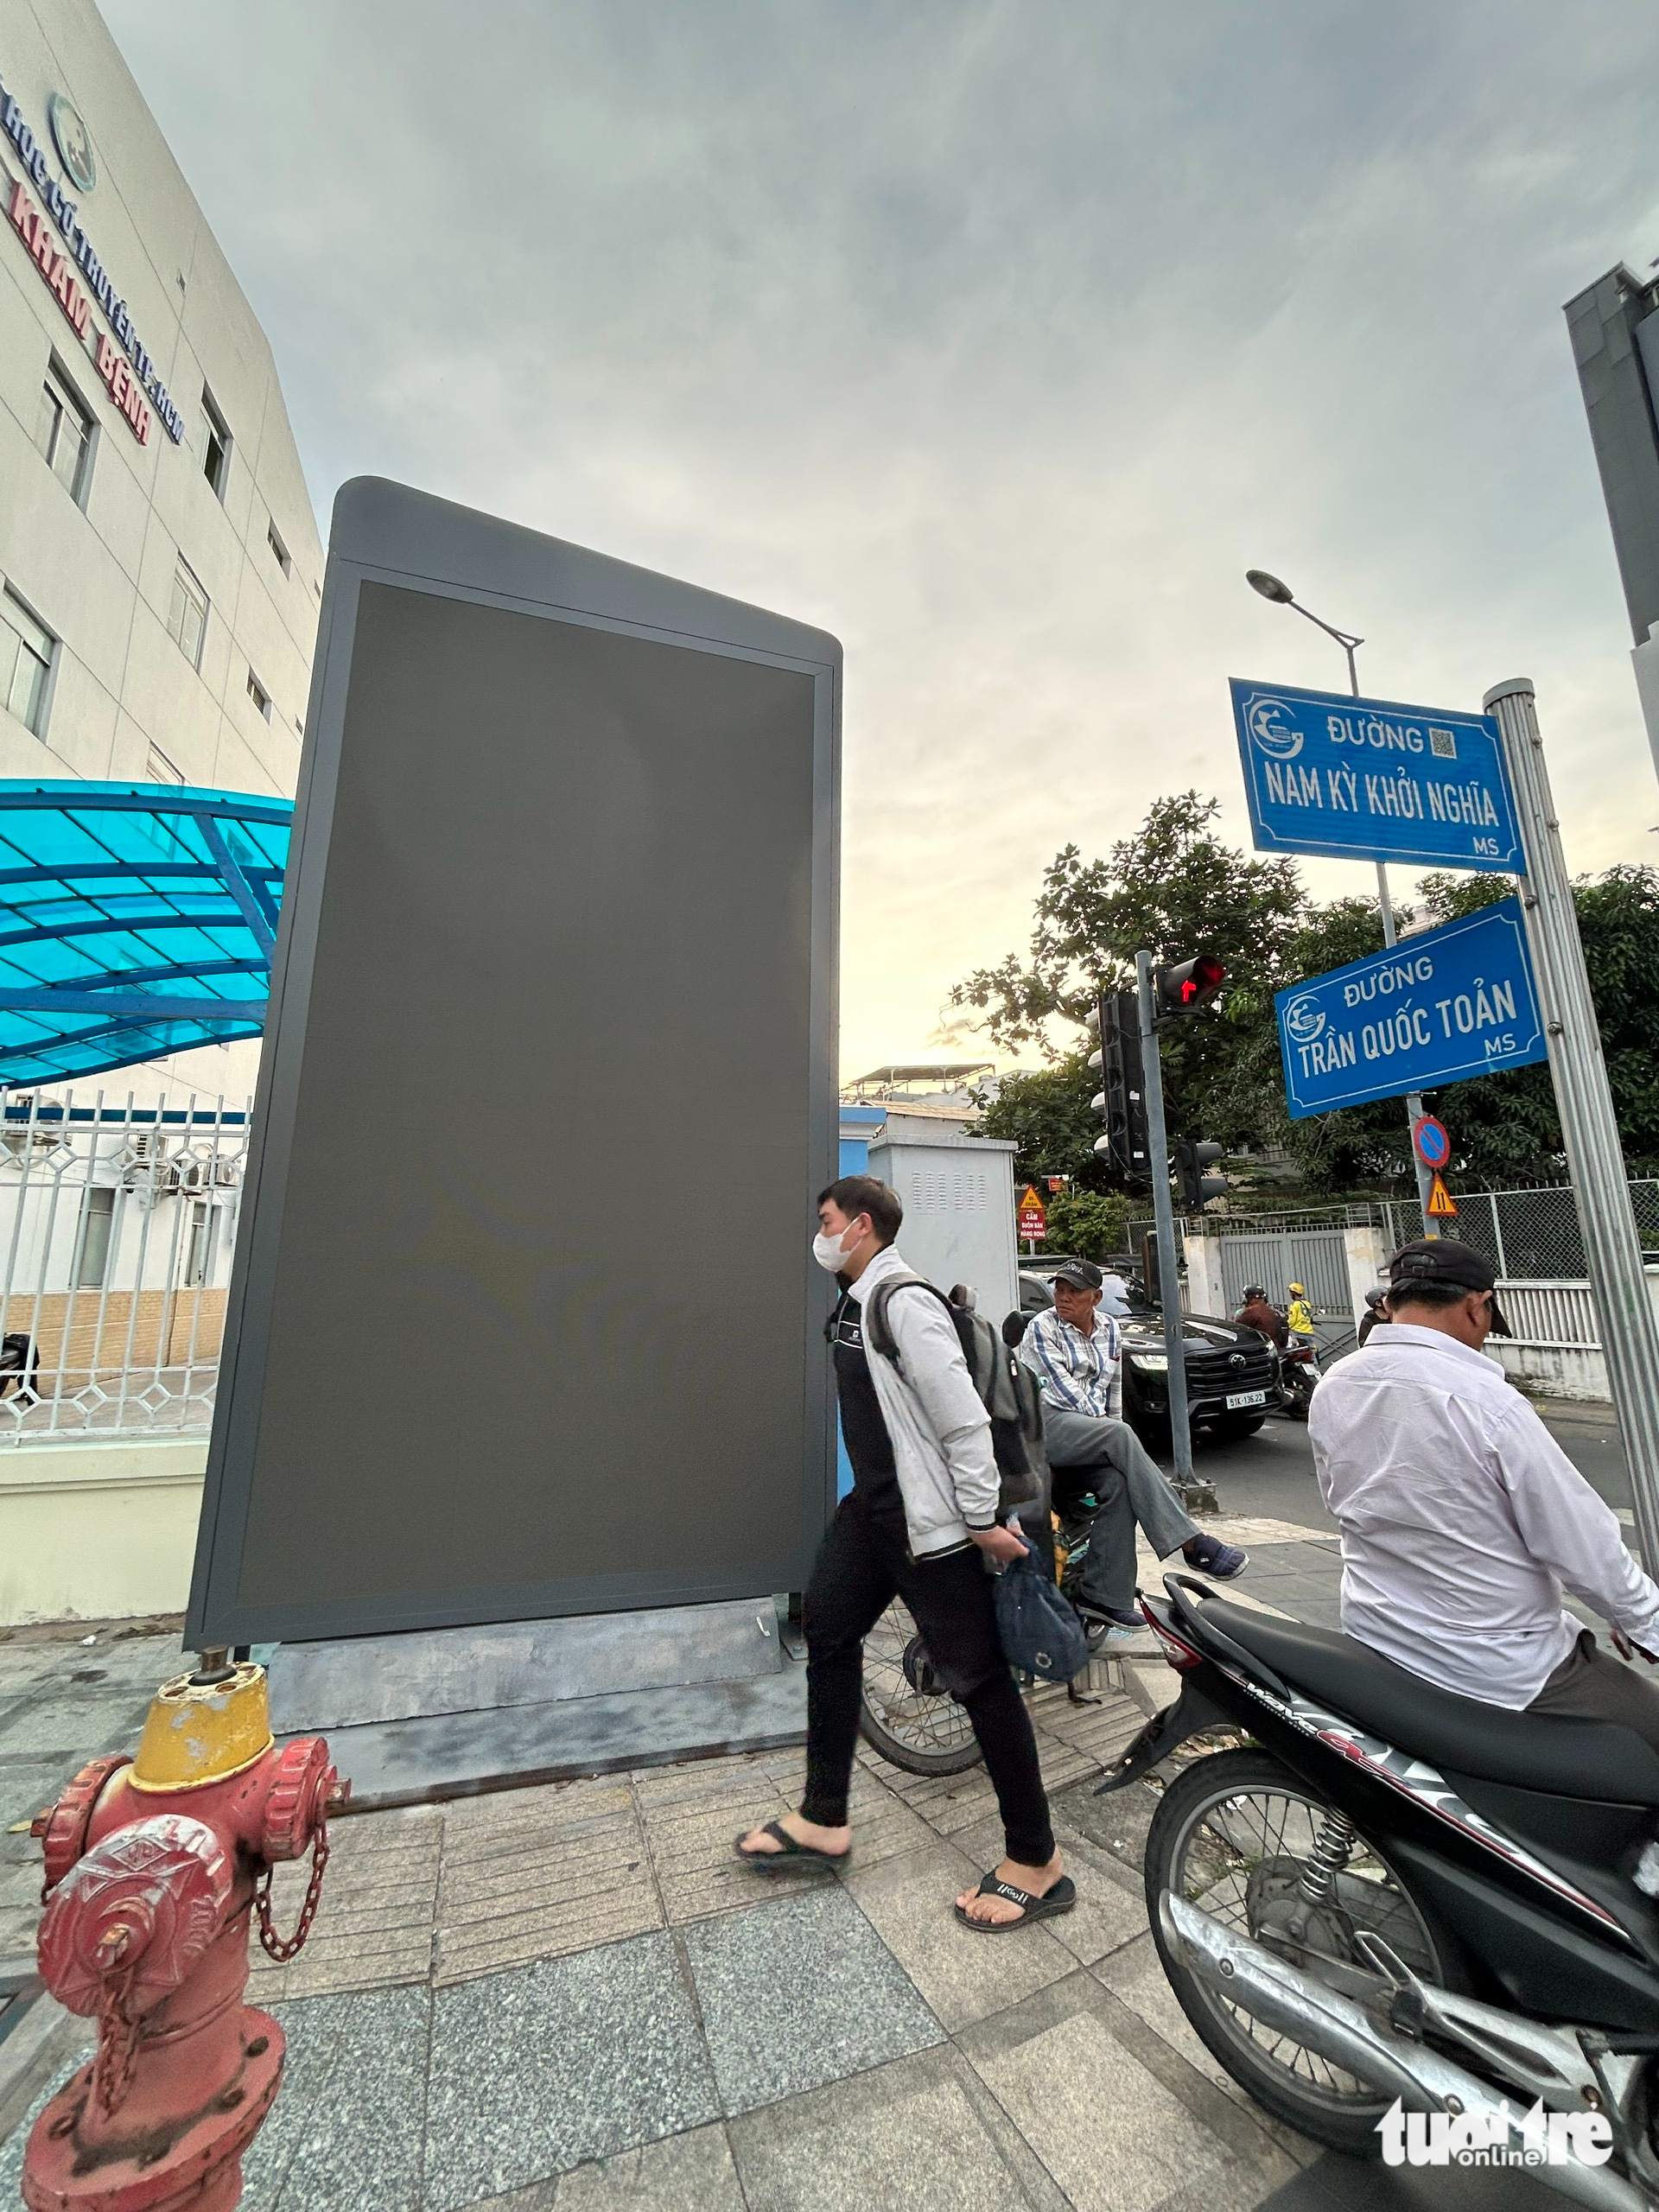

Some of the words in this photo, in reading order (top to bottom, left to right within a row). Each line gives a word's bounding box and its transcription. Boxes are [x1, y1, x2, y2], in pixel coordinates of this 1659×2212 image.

[9, 180, 92, 340] KHÁM
[97, 333, 152, 447] BỆNH
[1327, 715, 1424, 753] ĐƯỜNG
[1264, 761, 1323, 808] NAM
[1327, 761, 1358, 812] KỲ
[1364, 766, 1424, 820] KHỞI
[1427, 780, 1499, 827] NGHĨA
[1472, 836, 1499, 855] MS
[1344, 957, 1433, 1007] ĐƯỜNG
[1298, 1025, 1356, 1078] TRẦN
[1362, 998, 1431, 1060] QUỐC
[1435, 977, 1517, 1037] TOẢN
[1484, 1033, 1516, 1056] MS
